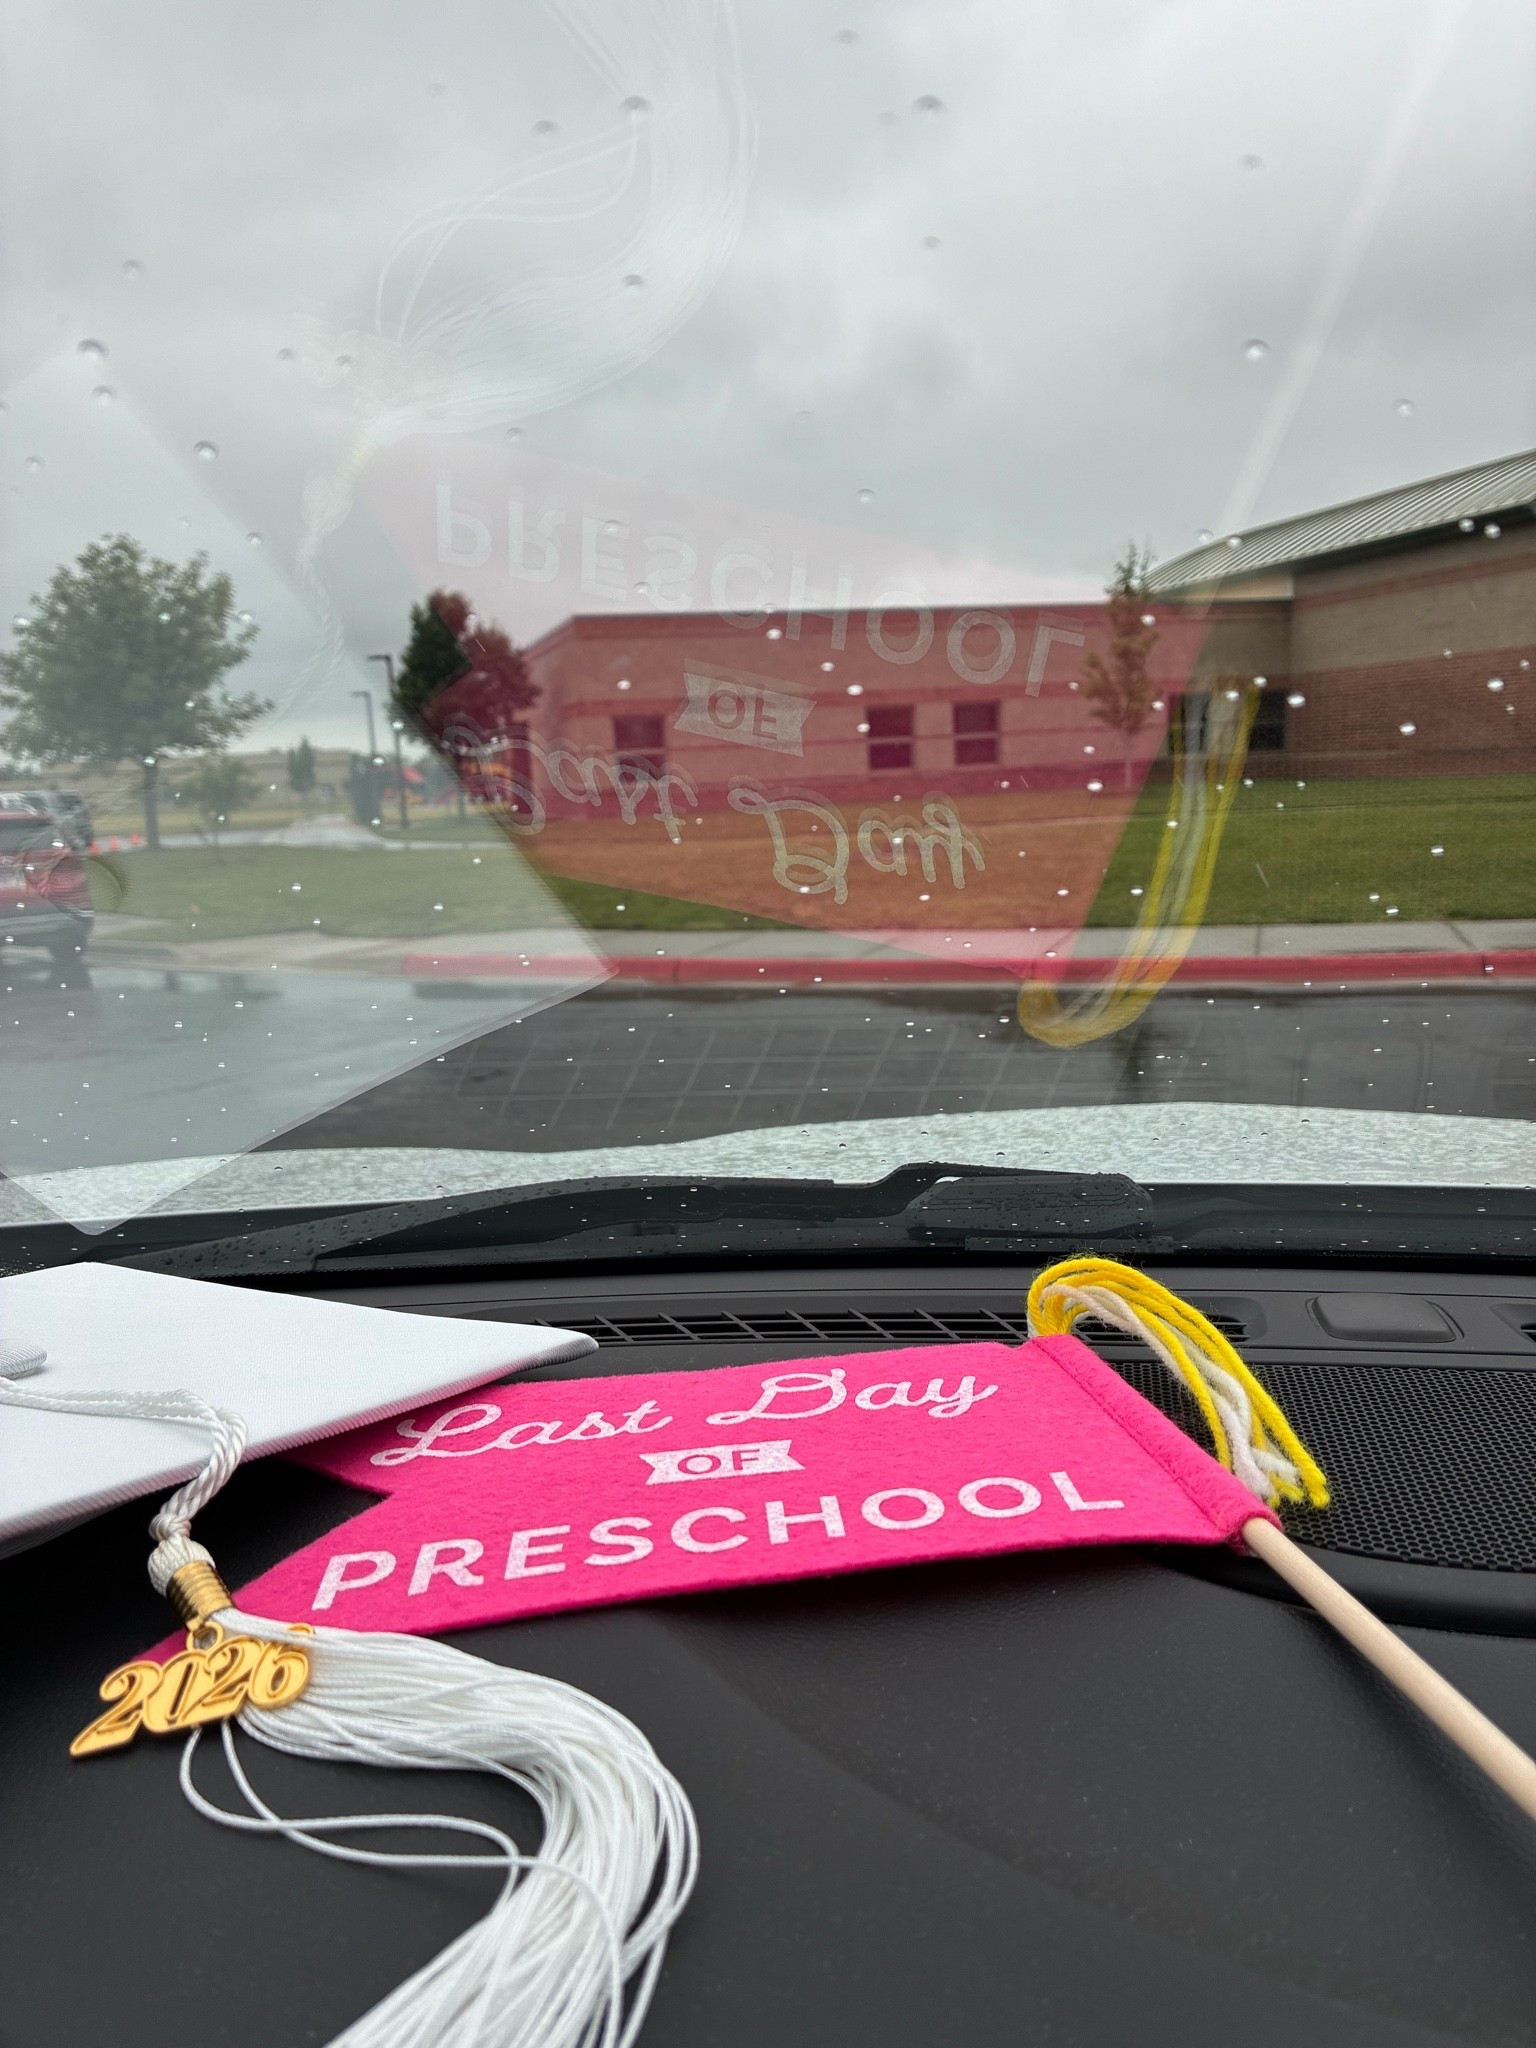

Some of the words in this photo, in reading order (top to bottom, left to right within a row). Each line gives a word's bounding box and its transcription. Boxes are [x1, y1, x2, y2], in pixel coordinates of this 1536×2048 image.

[369, 1400, 675, 1467] Last
[705, 1367, 1000, 1424] Day
[677, 1448, 761, 1475] OF
[310, 1470, 1125, 1611] PRESCHOOL
[69, 1623, 315, 1757] 2026
